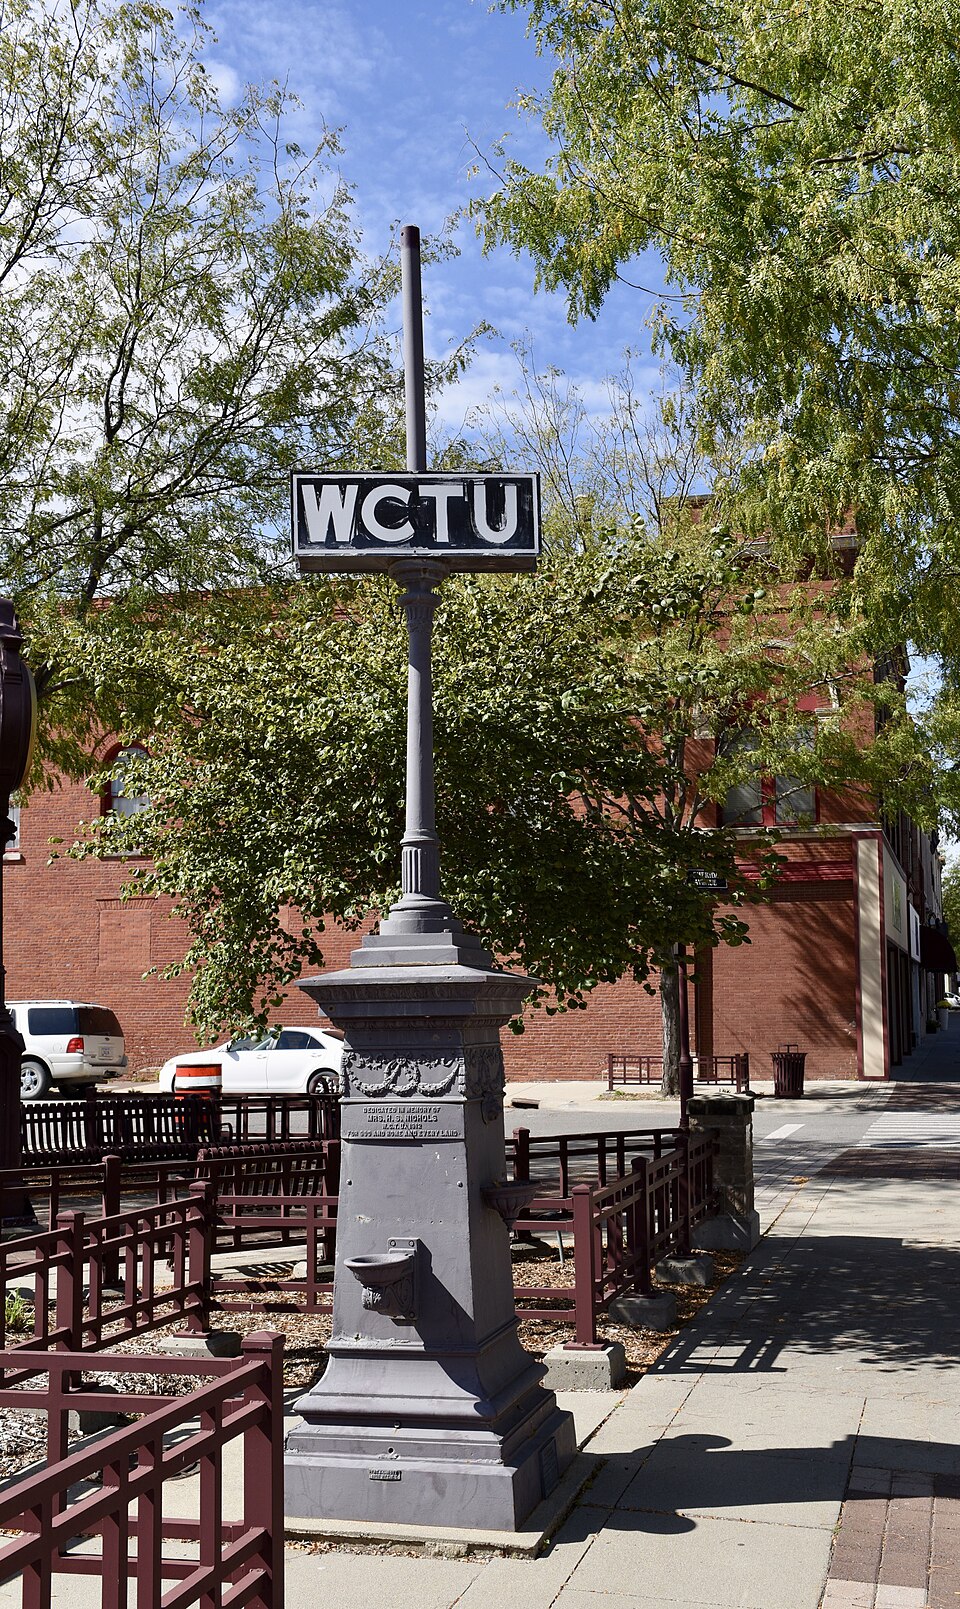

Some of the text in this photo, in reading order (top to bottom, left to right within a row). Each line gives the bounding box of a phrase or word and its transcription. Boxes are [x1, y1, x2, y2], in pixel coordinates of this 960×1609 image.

[301, 484, 518, 544] WCTU
[367, 1115, 386, 1123] MRS.
[386, 1115, 395, 1123] H.
[405, 1115, 438, 1123] NICHOLS
